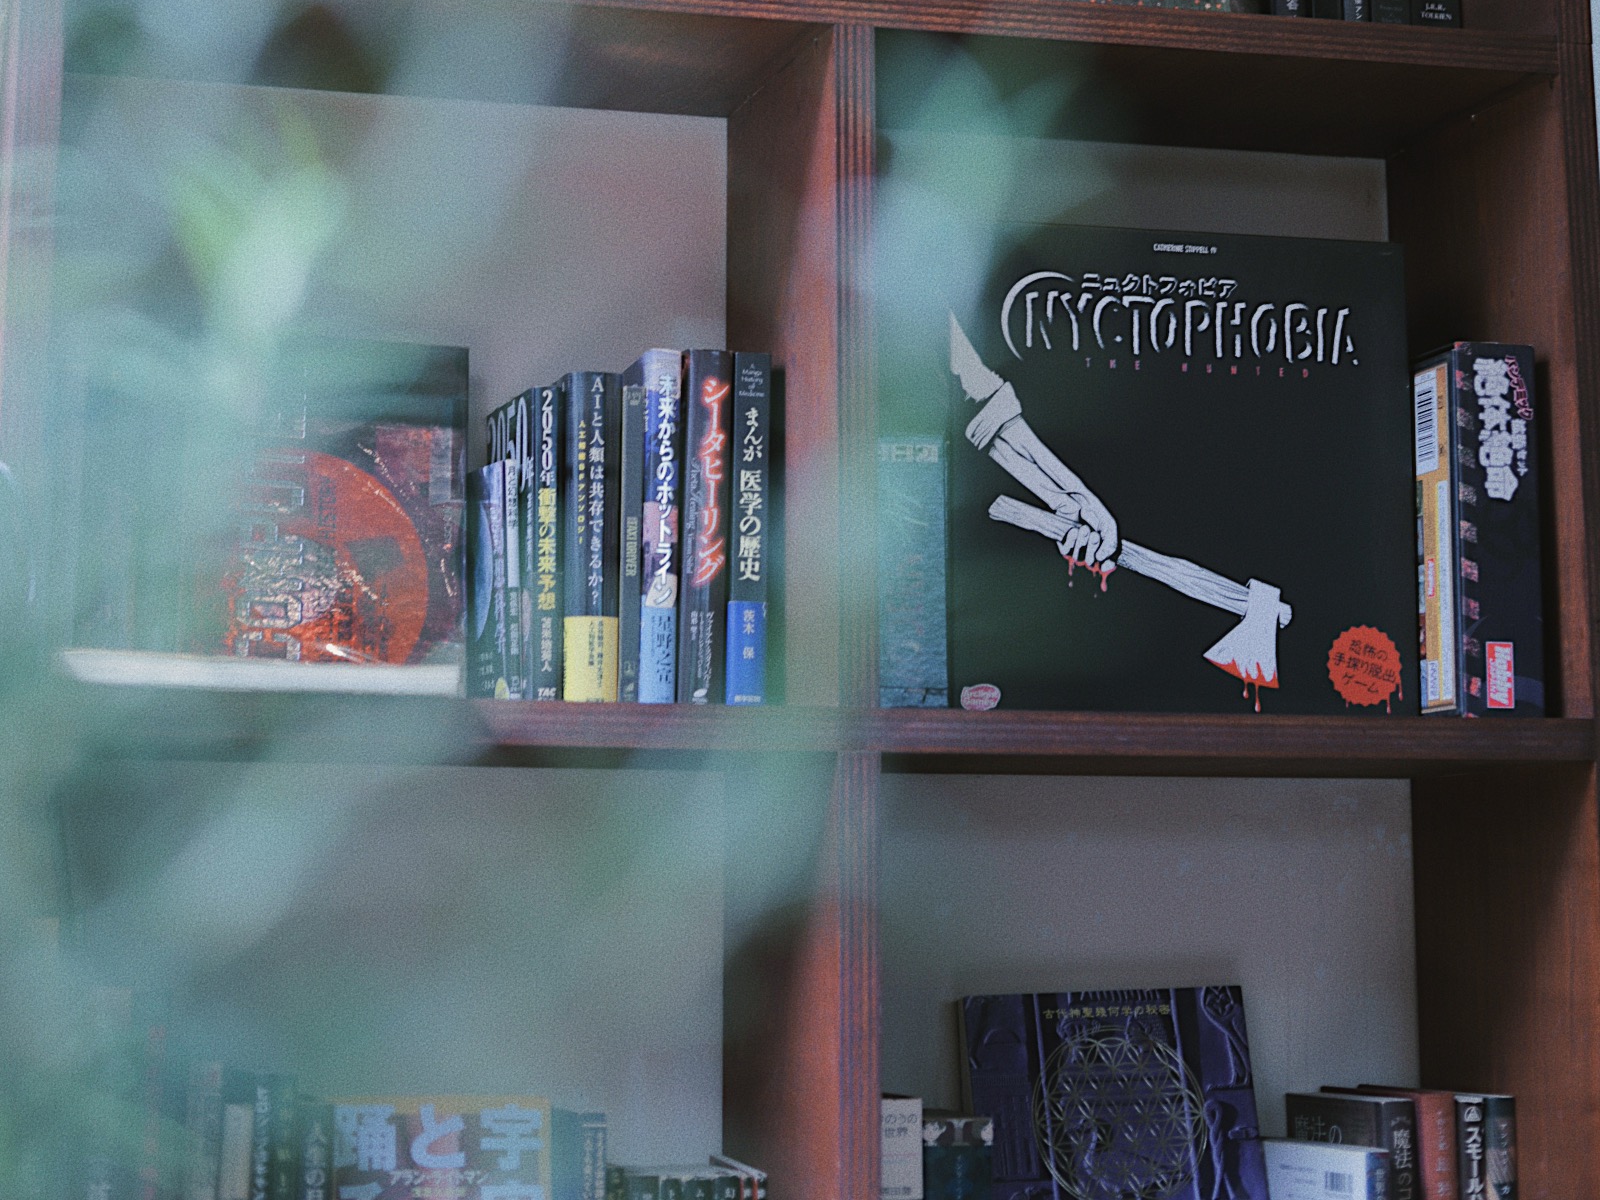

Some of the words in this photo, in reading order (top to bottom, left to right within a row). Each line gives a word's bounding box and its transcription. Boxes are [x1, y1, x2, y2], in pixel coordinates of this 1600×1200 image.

[1420, 11, 1453, 21] TOLKIEN
[1081, 271, 1239, 298] ニュクトフォビア
[1021, 288, 1360, 366] NYCTOPHOBIA
[1085, 357, 1141, 371] THE
[1181, 362, 1310, 378] HUNTED
[540, 389, 556, 486] 2050年
[742, 407, 763, 463] まんが
[588, 376, 605, 607] AIと人類は共存できるか？
[655, 375, 675, 608] 未来からのホットライン
[696, 378, 730, 583] シータヒーリング
[537, 487, 557, 610] 衝撃の未来予想
[739, 469, 763, 582] 医学の歴史
[625, 541, 638, 577] DRIVER
[1333, 651, 1397, 684] 手探り脱出
[1349, 639, 1388, 662] 恐怖の
[1491, 647, 1513, 705] Hobby
[538, 687, 557, 698] TAC
[1342, 672, 1379, 693] ゲーム
[411, 1103, 466, 1169] と
[882, 1111, 919, 1126] のうの
